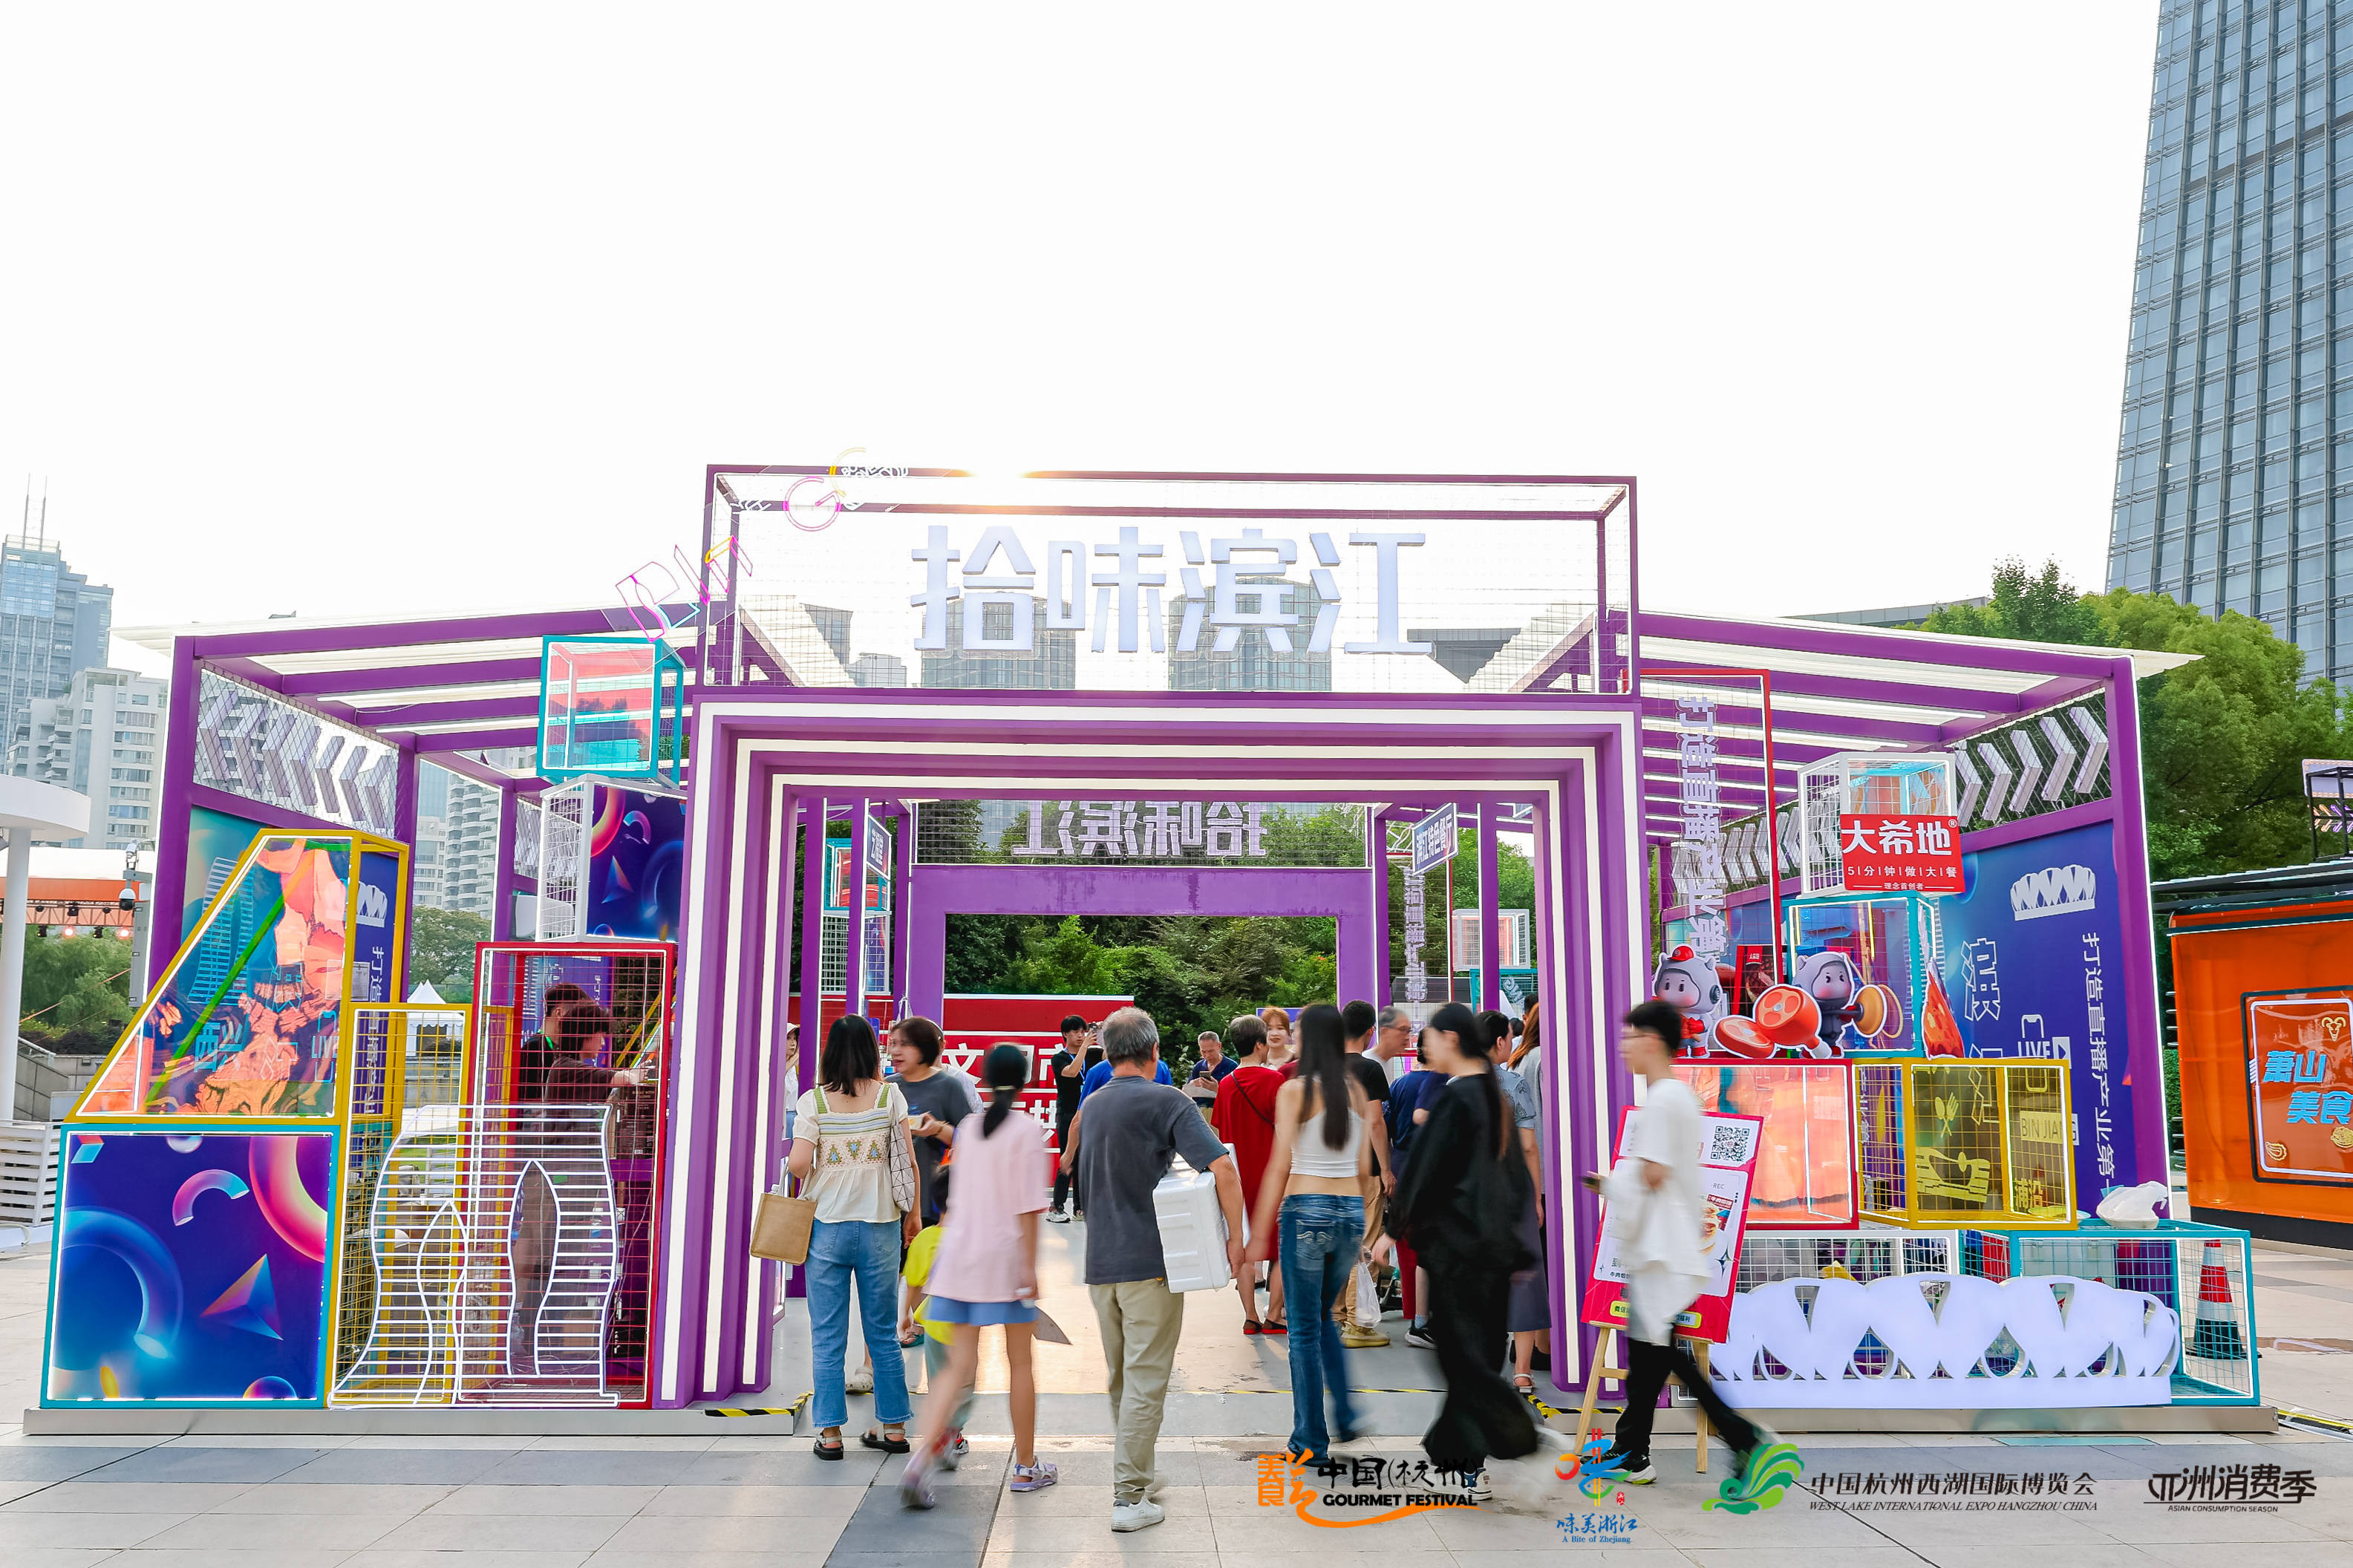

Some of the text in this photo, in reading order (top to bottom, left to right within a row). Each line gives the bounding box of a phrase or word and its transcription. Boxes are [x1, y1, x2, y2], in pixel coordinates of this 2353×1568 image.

[911, 525, 1432, 655] 拾味滨江
[1841, 820, 1952, 855] 大希地
[2262, 1050, 2327, 1083] 萧山
[2286, 1091, 2353, 1125] 美食
[2021, 1117, 2040, 1138] BIN
